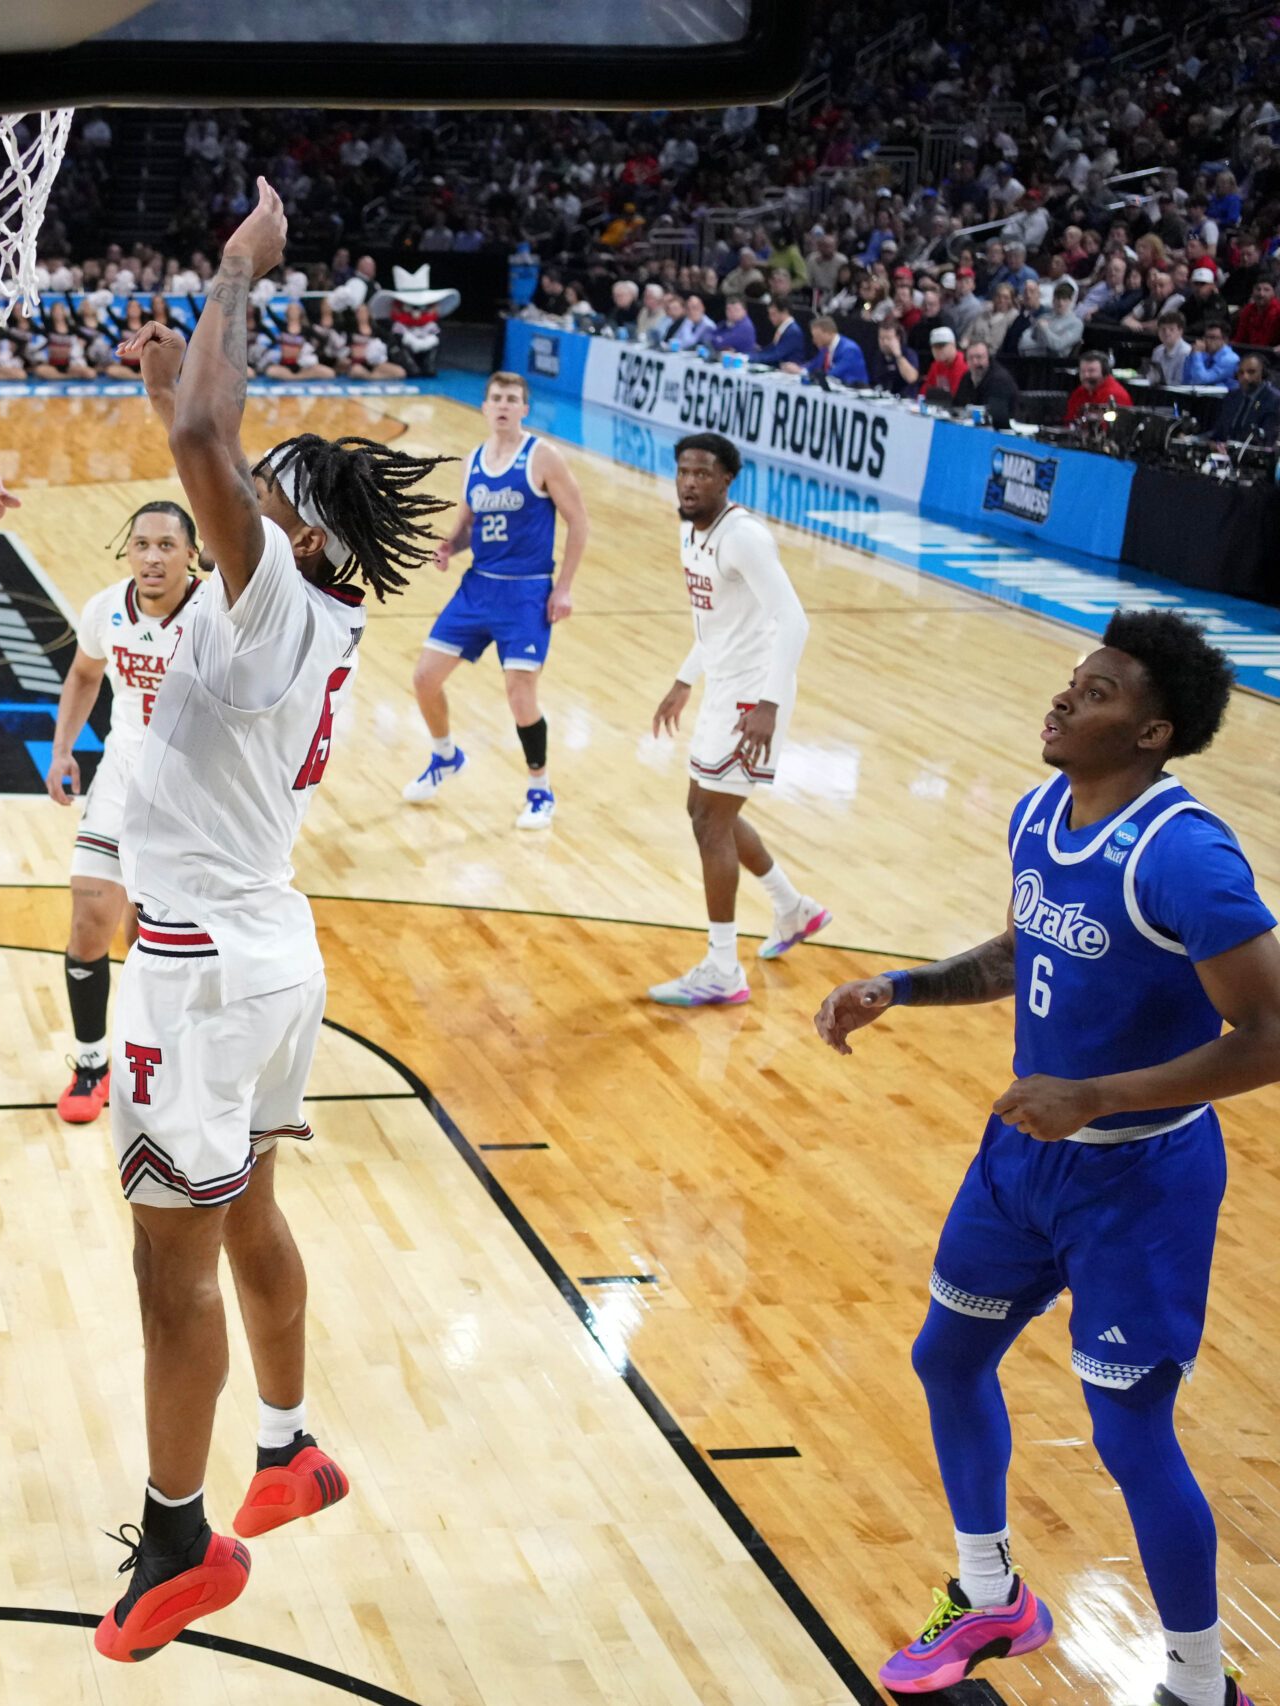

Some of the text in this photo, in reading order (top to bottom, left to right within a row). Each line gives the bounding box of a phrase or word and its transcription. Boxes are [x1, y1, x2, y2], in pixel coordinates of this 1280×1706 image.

[613, 351, 664, 415] FIRST
[680, 367, 764, 443] SECOND
[770, 390, 888, 479] ROUNDS
[470, 484, 525, 513] Drake
[482, 514, 508, 542] 22
[112, 645, 170, 675] TEXA
[117, 664, 162, 691] TEC
[1014, 869, 1110, 959] Drake
[1029, 954, 1053, 1018] 6
